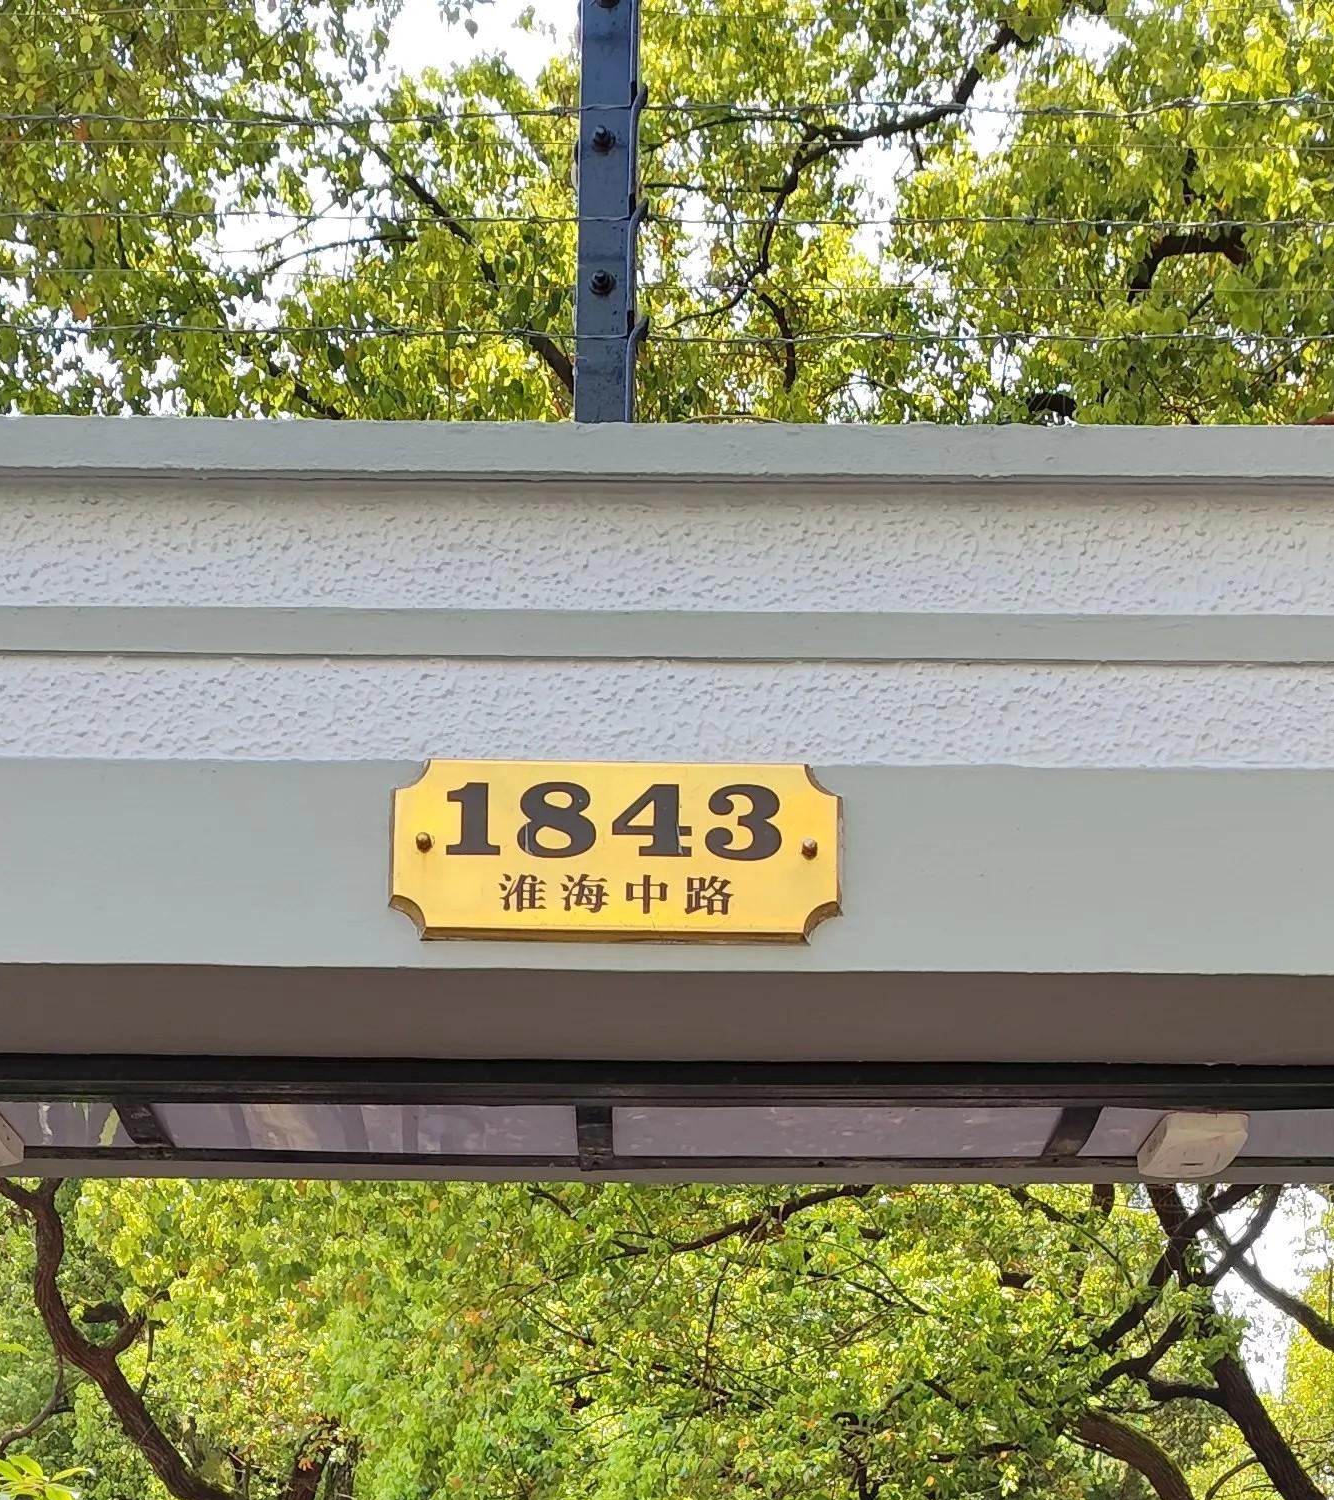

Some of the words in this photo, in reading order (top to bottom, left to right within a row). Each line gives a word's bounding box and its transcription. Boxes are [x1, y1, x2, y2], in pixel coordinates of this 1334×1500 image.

[445, 781, 783, 862] 1843
[498, 873, 734, 916] 淮海中路
